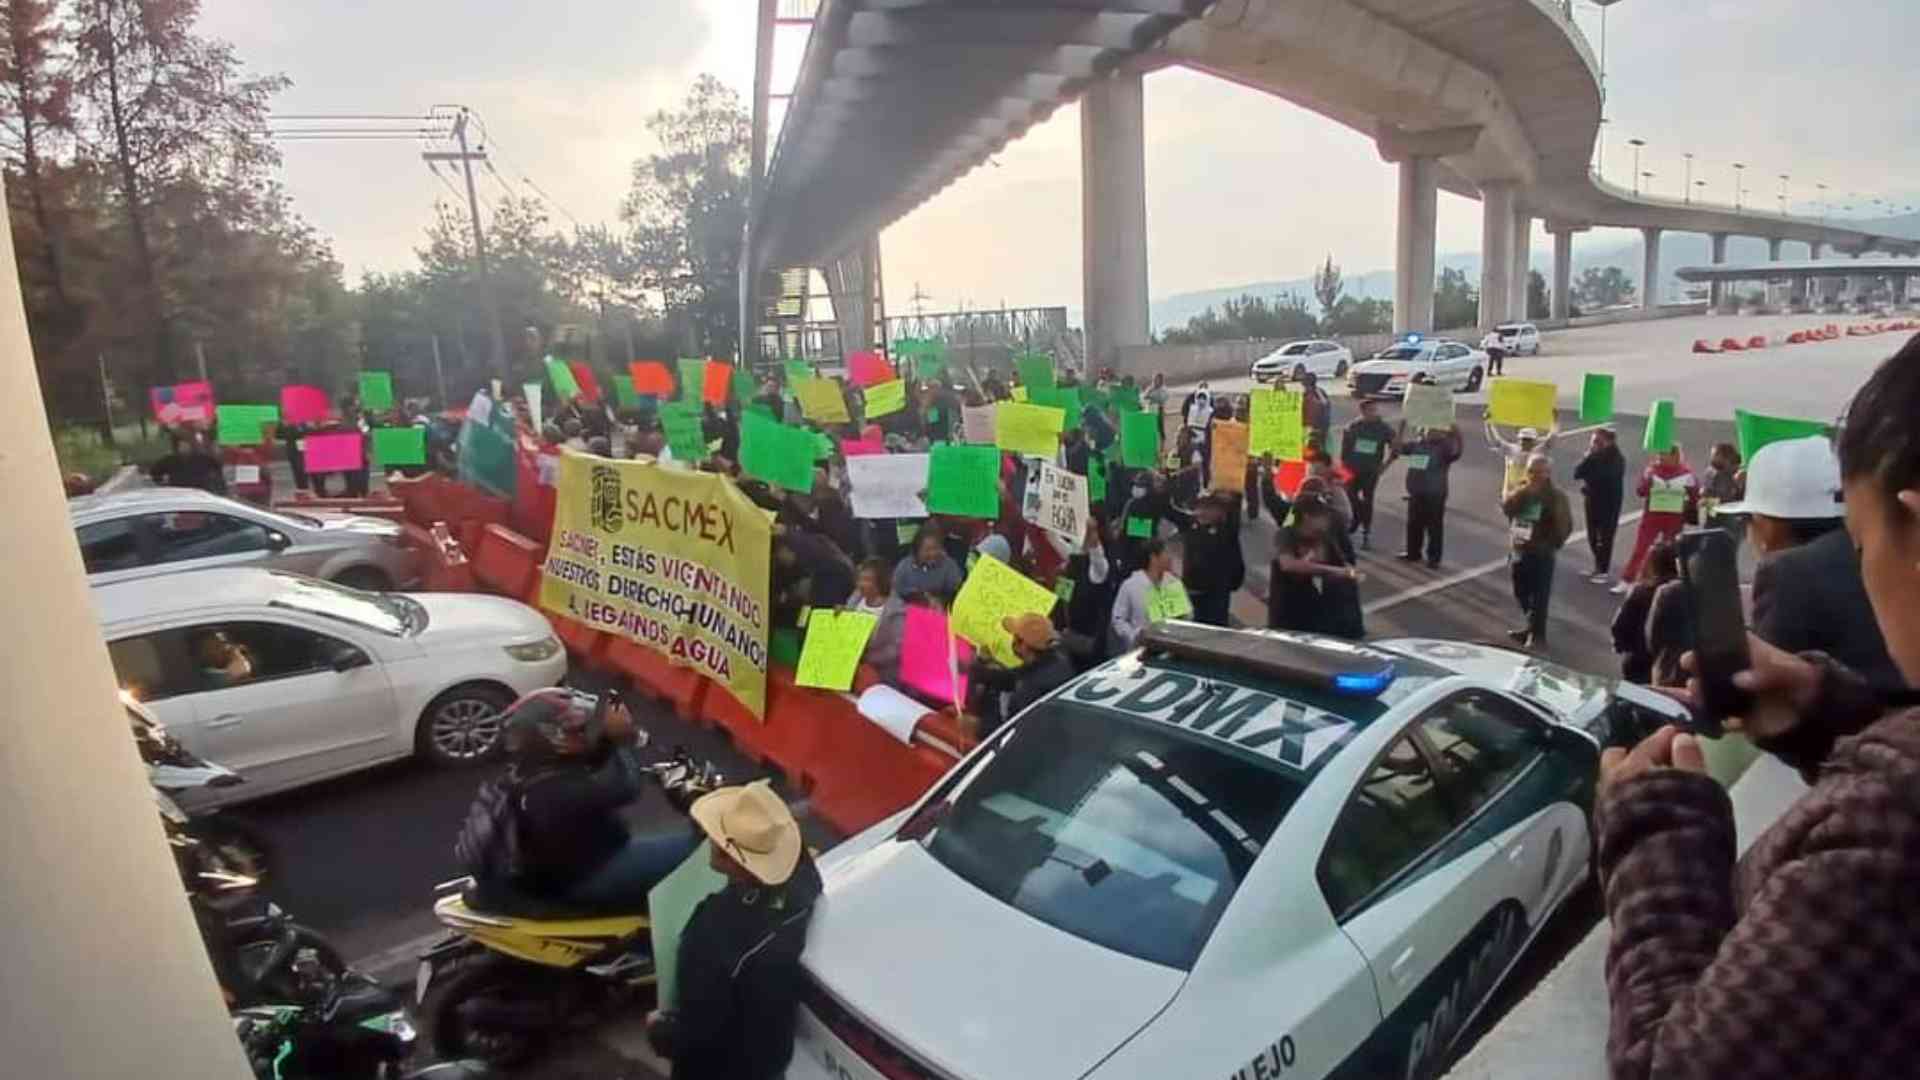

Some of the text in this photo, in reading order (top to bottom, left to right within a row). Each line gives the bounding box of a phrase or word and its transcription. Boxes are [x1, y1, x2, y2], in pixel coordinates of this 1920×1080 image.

[627, 489, 734, 553] SACMEX
[671, 636, 731, 680] AGUA
[1075, 667, 1347, 765] CDMX
